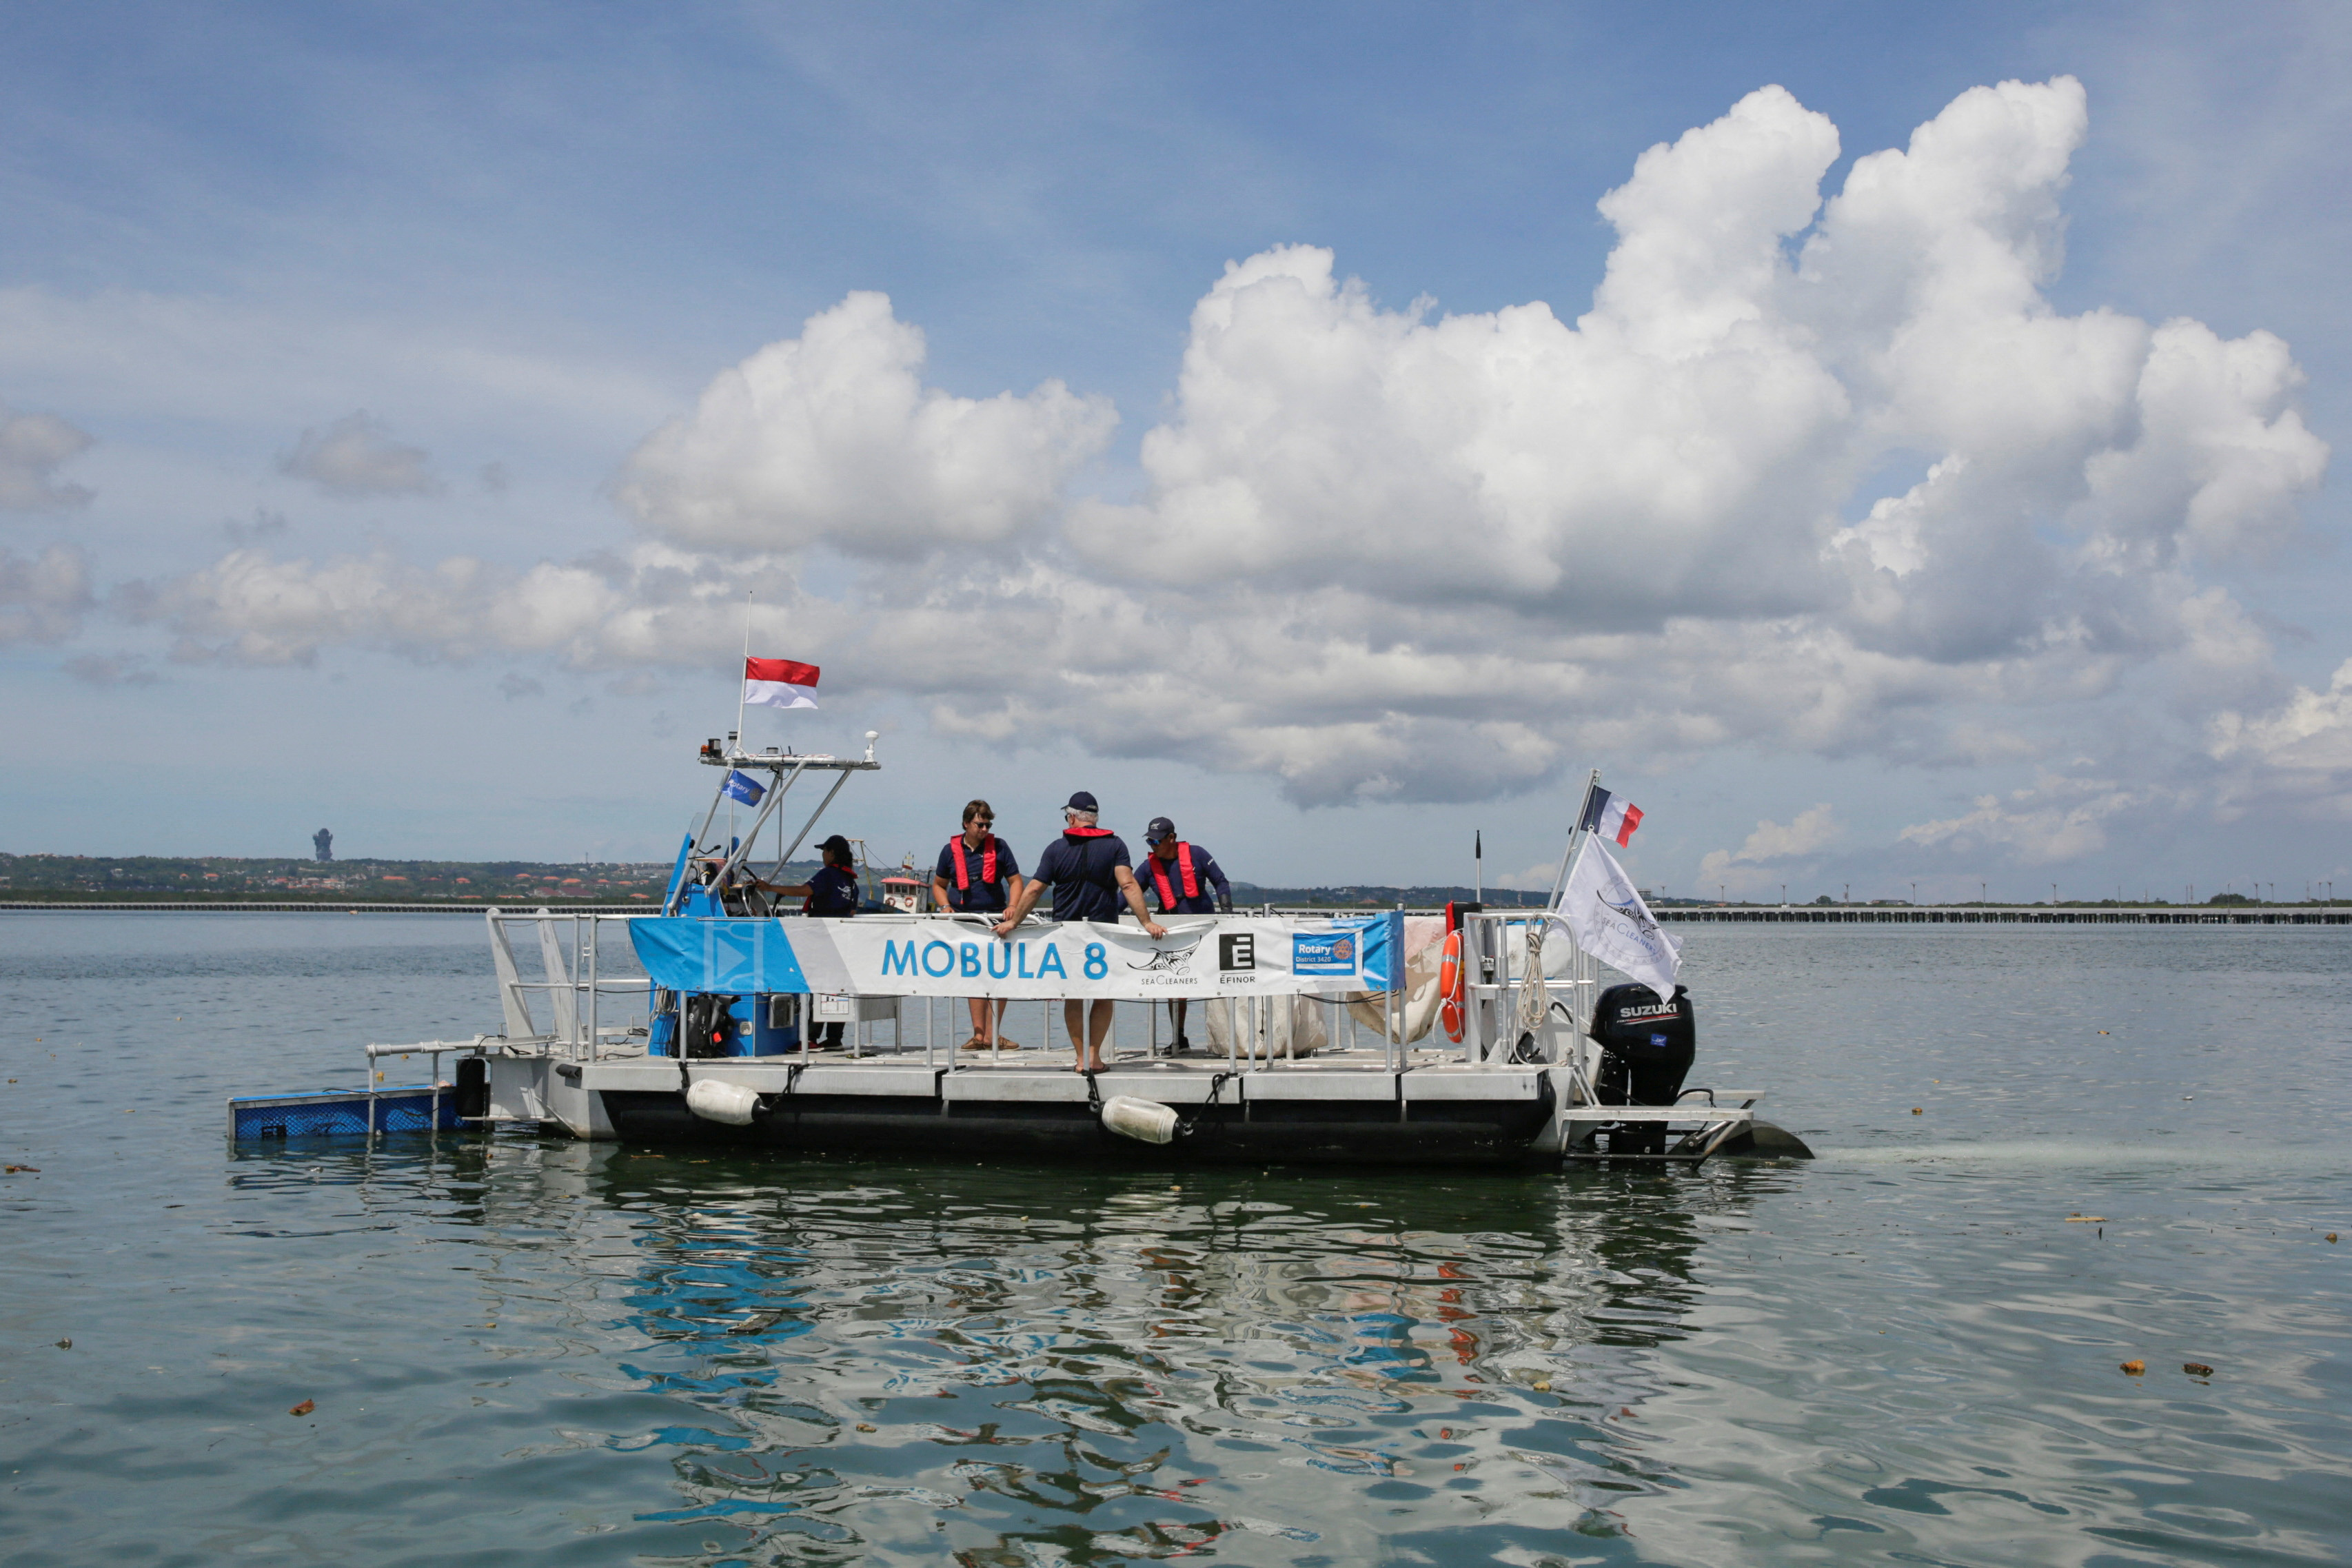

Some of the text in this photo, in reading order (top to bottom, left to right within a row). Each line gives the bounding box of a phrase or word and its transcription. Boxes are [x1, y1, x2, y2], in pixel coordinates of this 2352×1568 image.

[728, 780, 750, 794] Rotary
[1298, 944, 1331, 956] Rotary
[881, 939, 1108, 980] MOBULA 8
[1620, 1004, 1677, 1018] SUZUKI
